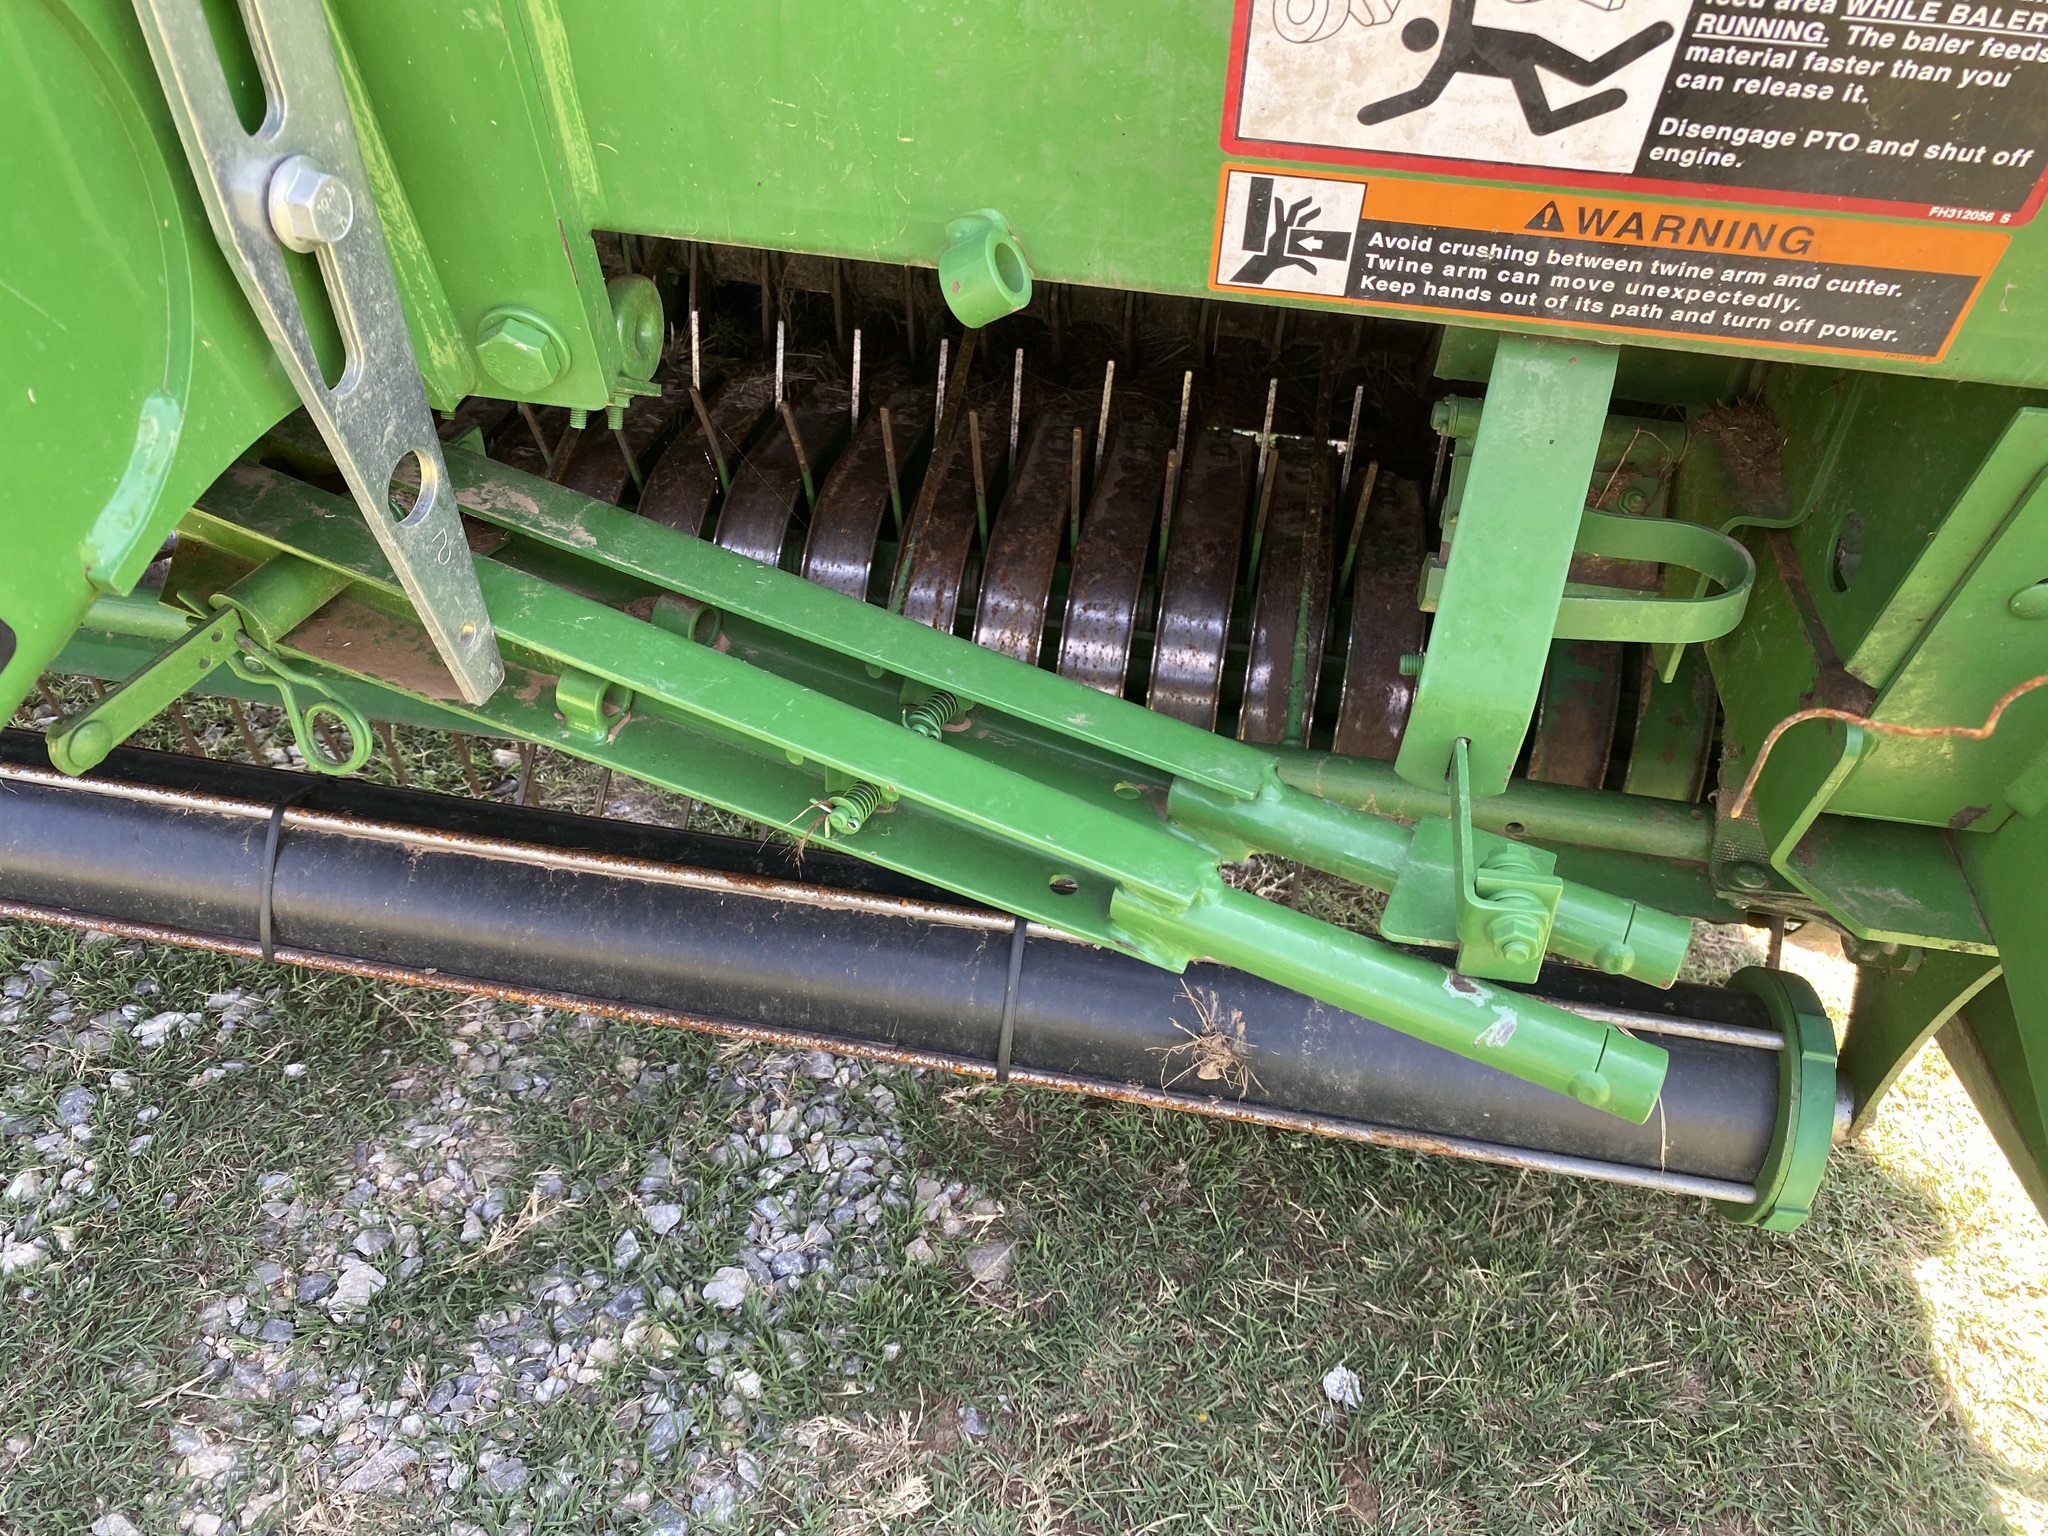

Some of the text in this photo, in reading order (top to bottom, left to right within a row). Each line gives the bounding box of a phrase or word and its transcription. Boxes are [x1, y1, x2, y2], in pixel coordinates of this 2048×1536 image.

[1694, 13, 2048, 62] RUNNING. The baler feeds
[1845, 0, 1942, 22] WHILE
[1947, 3, 2048, 32] BALER
[1676, 74, 1868, 103] can release it.
[1685, 46, 2011, 88] material faster than you
[1650, 147, 1742, 167] engine.
[1659, 118, 2034, 167] Disengage PTO and shut off
[1577, 206, 1816, 256] WARNING
[1929, 206, 2011, 223] FH312056 S
[1366, 254, 1803, 313] Twine arm can move unexpectedly.
[1367, 231, 1902, 297] Avoid crushing between twine arm and cutter.
[1361, 275, 1898, 342] Keep hands out of its path and turn off power.
